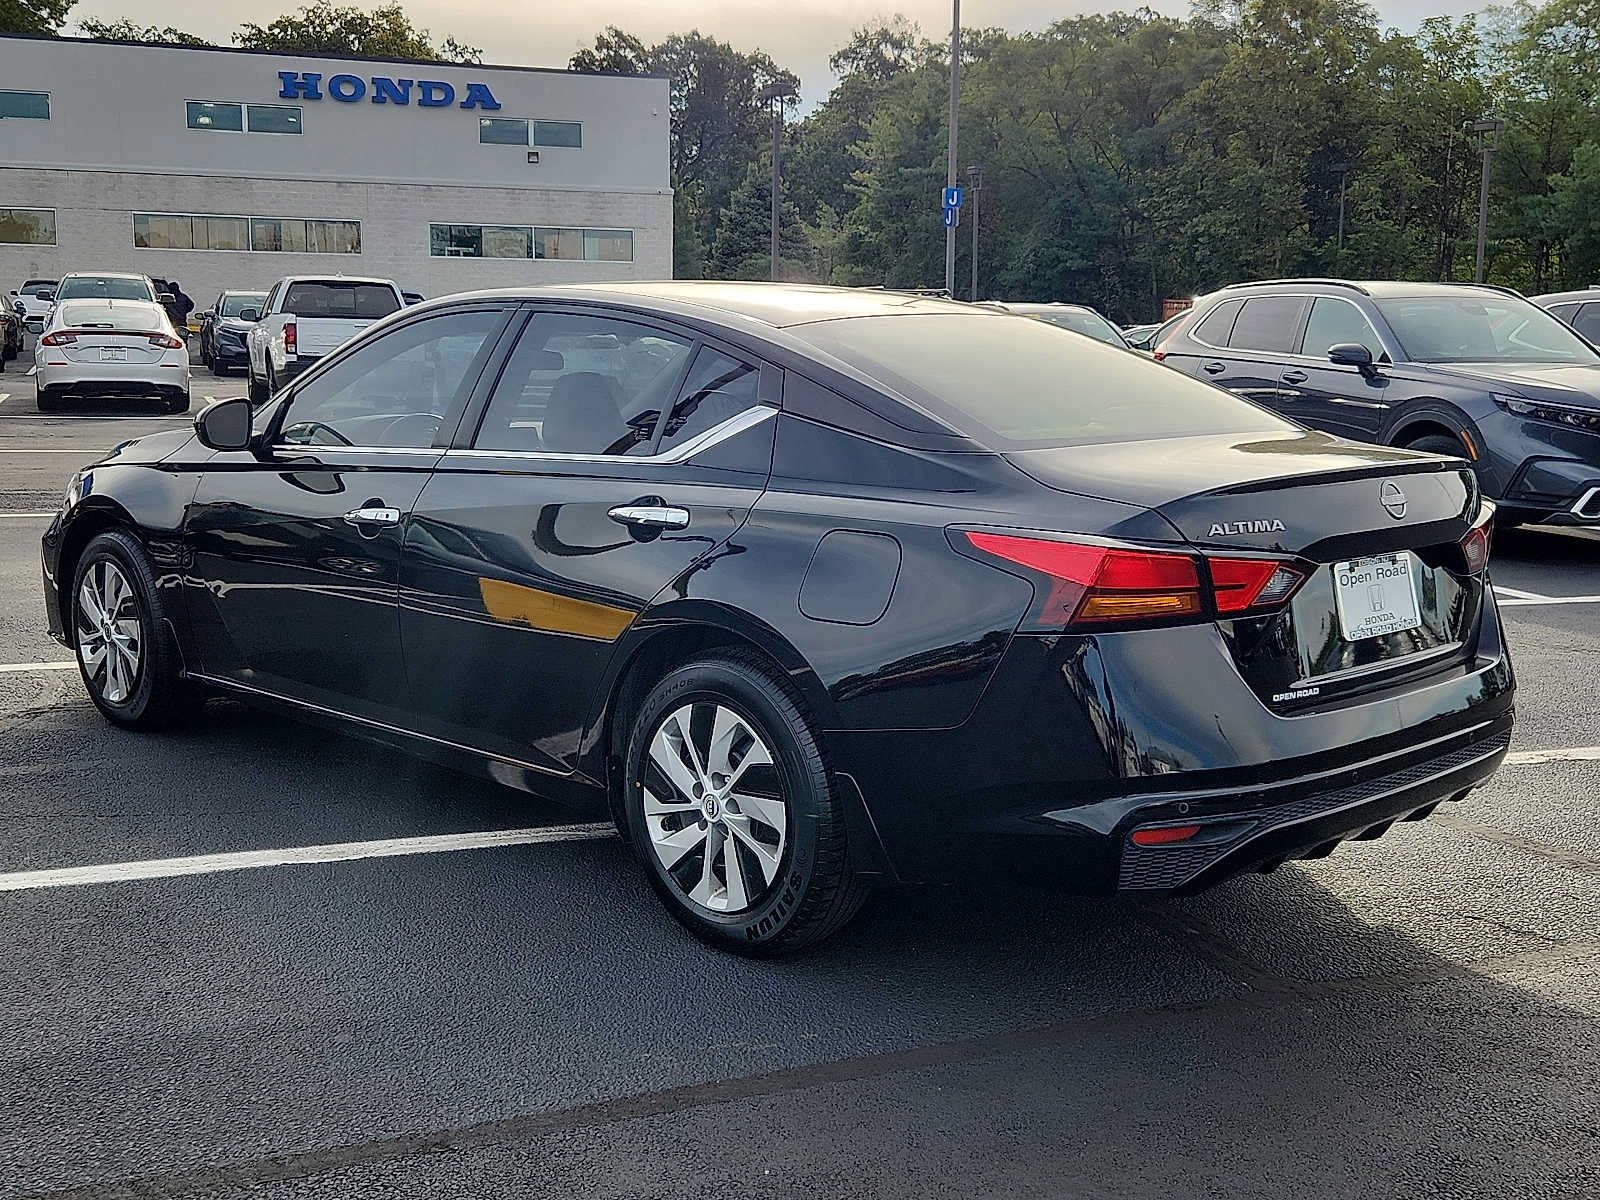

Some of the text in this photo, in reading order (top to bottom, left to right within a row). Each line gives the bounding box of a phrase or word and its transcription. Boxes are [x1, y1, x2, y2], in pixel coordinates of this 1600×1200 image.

[278, 71, 501, 110] HONDA
[949, 190, 957, 205] J
[945, 209, 951, 225] J
[1207, 519, 1286, 537] ALTIMA
[1340, 564, 1407, 588] Open Road
[1364, 612, 1395, 626] HONDA
[1350, 628, 1372, 639] OPEN
[1371, 623, 1394, 635] ROAD
[1272, 687, 1320, 702] OPEN ROAD
[745, 870, 803, 940] SAILUN
